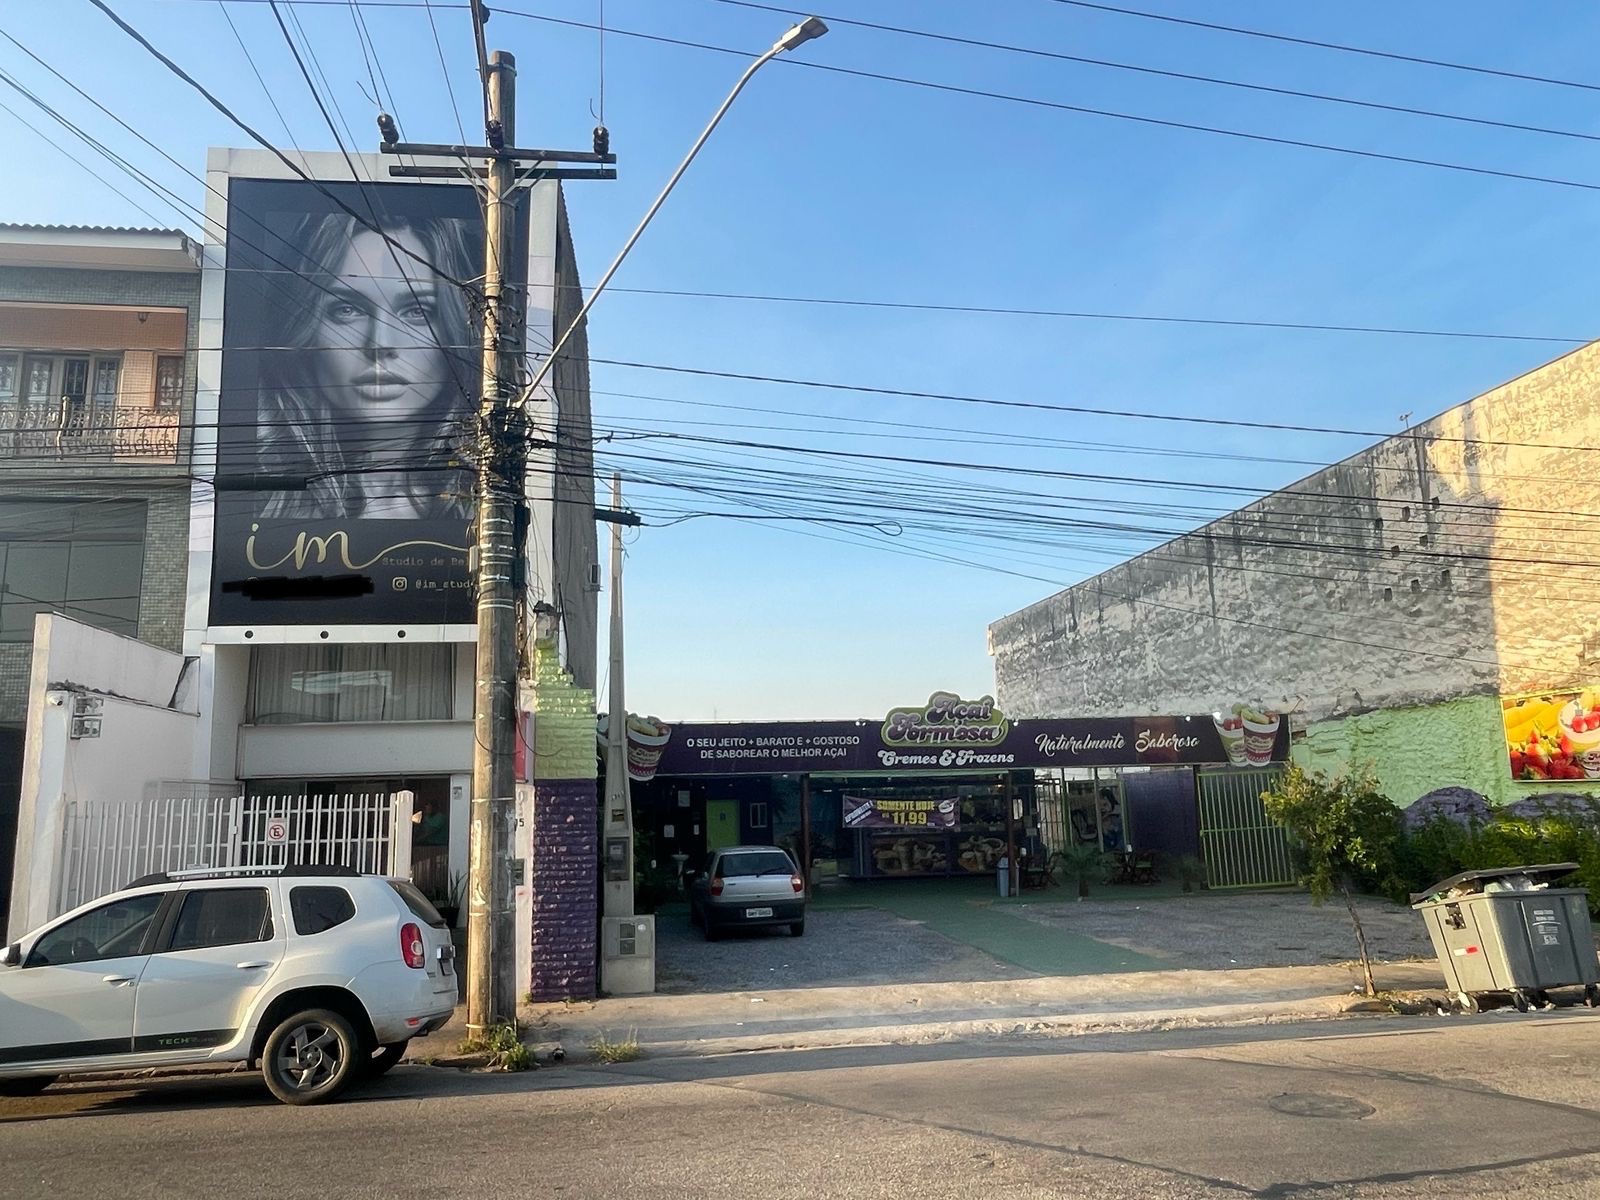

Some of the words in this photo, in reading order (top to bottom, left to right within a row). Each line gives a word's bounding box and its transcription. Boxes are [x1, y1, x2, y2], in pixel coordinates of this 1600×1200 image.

[382, 557, 424, 567] Studio
[430, 557, 445, 567] de
[887, 712, 1003, 744] Formosa
[687, 738, 694, 748] O
[697, 738, 716, 748] SEU
[718, 737, 746, 747] JEITO
[756, 737, 795, 747] BARATO
[797, 736, 803, 746] E
[813, 736, 860, 746] GOSTOSO
[1034, 732, 1126, 757] Naturalmente
[1134, 729, 1199, 753] Saboroso
[700, 750, 714, 759] DE
[716, 749, 769, 759] SABOREAR
[772, 749, 779, 758] O
[781, 748, 822, 758] MELHOR
[938, 750, 956, 767] &
[955, 750, 1014, 766] Frozens
[876, 800, 914, 811] SOMENTE
[916, 800, 935, 811] HOJE
[892, 811, 927, 826] 11,99
